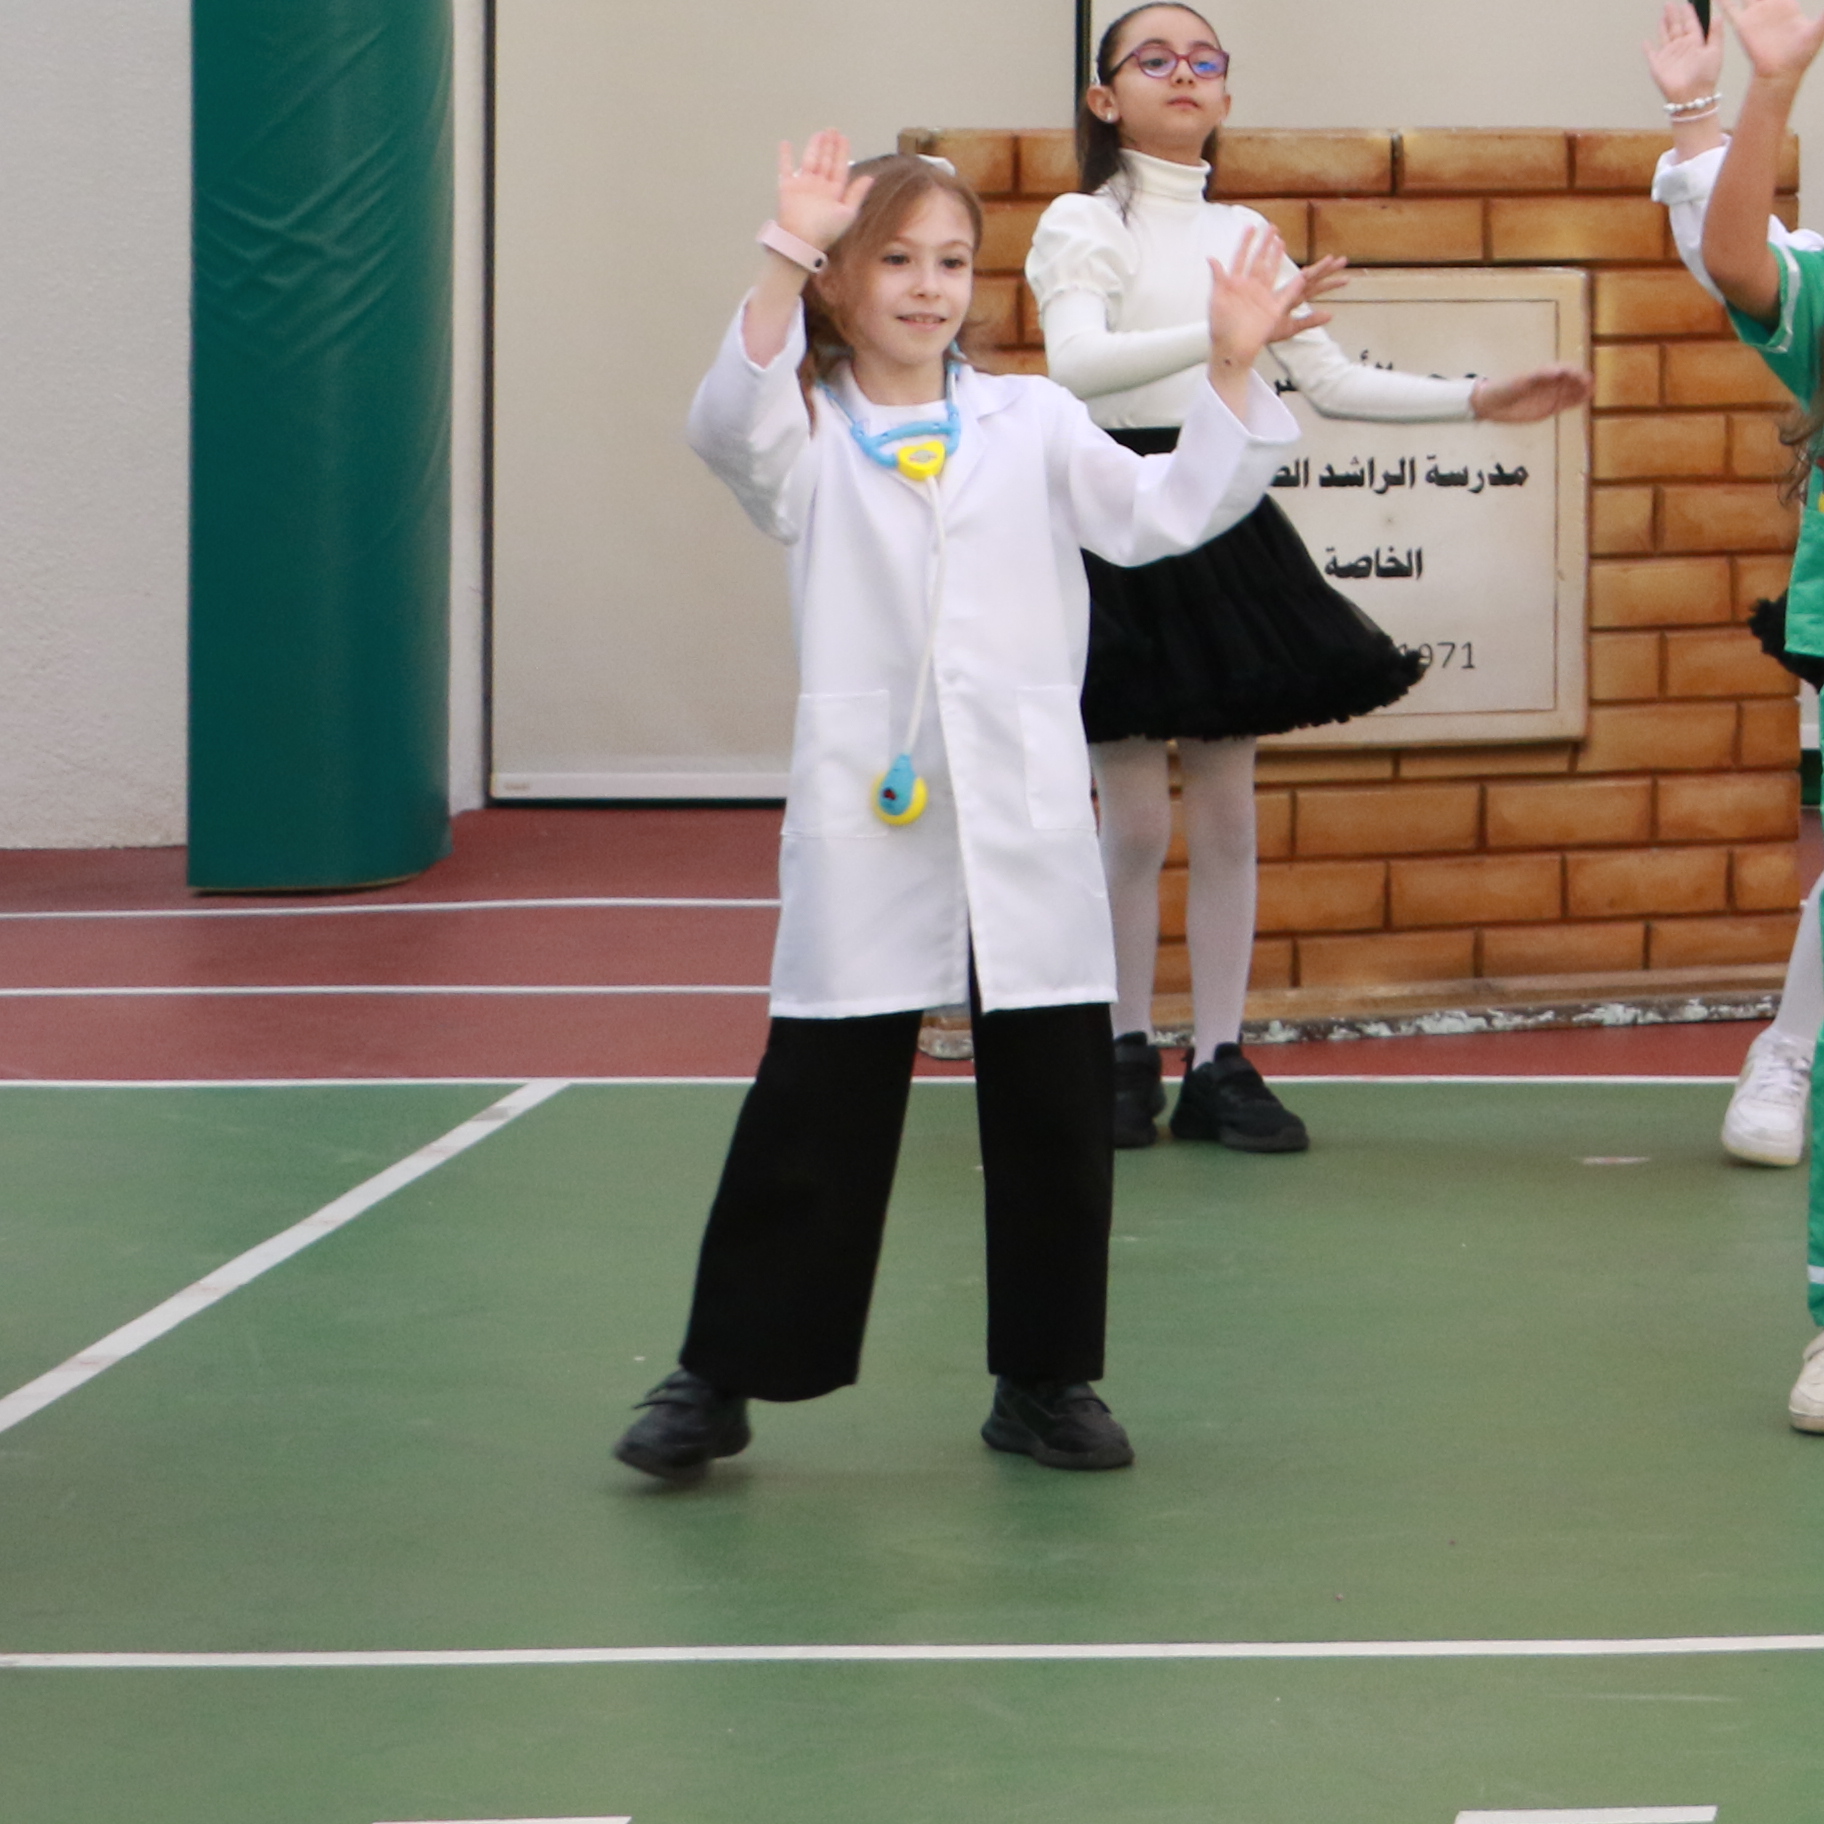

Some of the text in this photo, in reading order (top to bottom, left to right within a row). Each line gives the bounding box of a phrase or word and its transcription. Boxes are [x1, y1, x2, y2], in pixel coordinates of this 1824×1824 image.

[1318, 454, 1417, 495] الراشد
[1424, 453, 1530, 494] مدرسة
[1323, 546, 1424, 580] الخاصة
